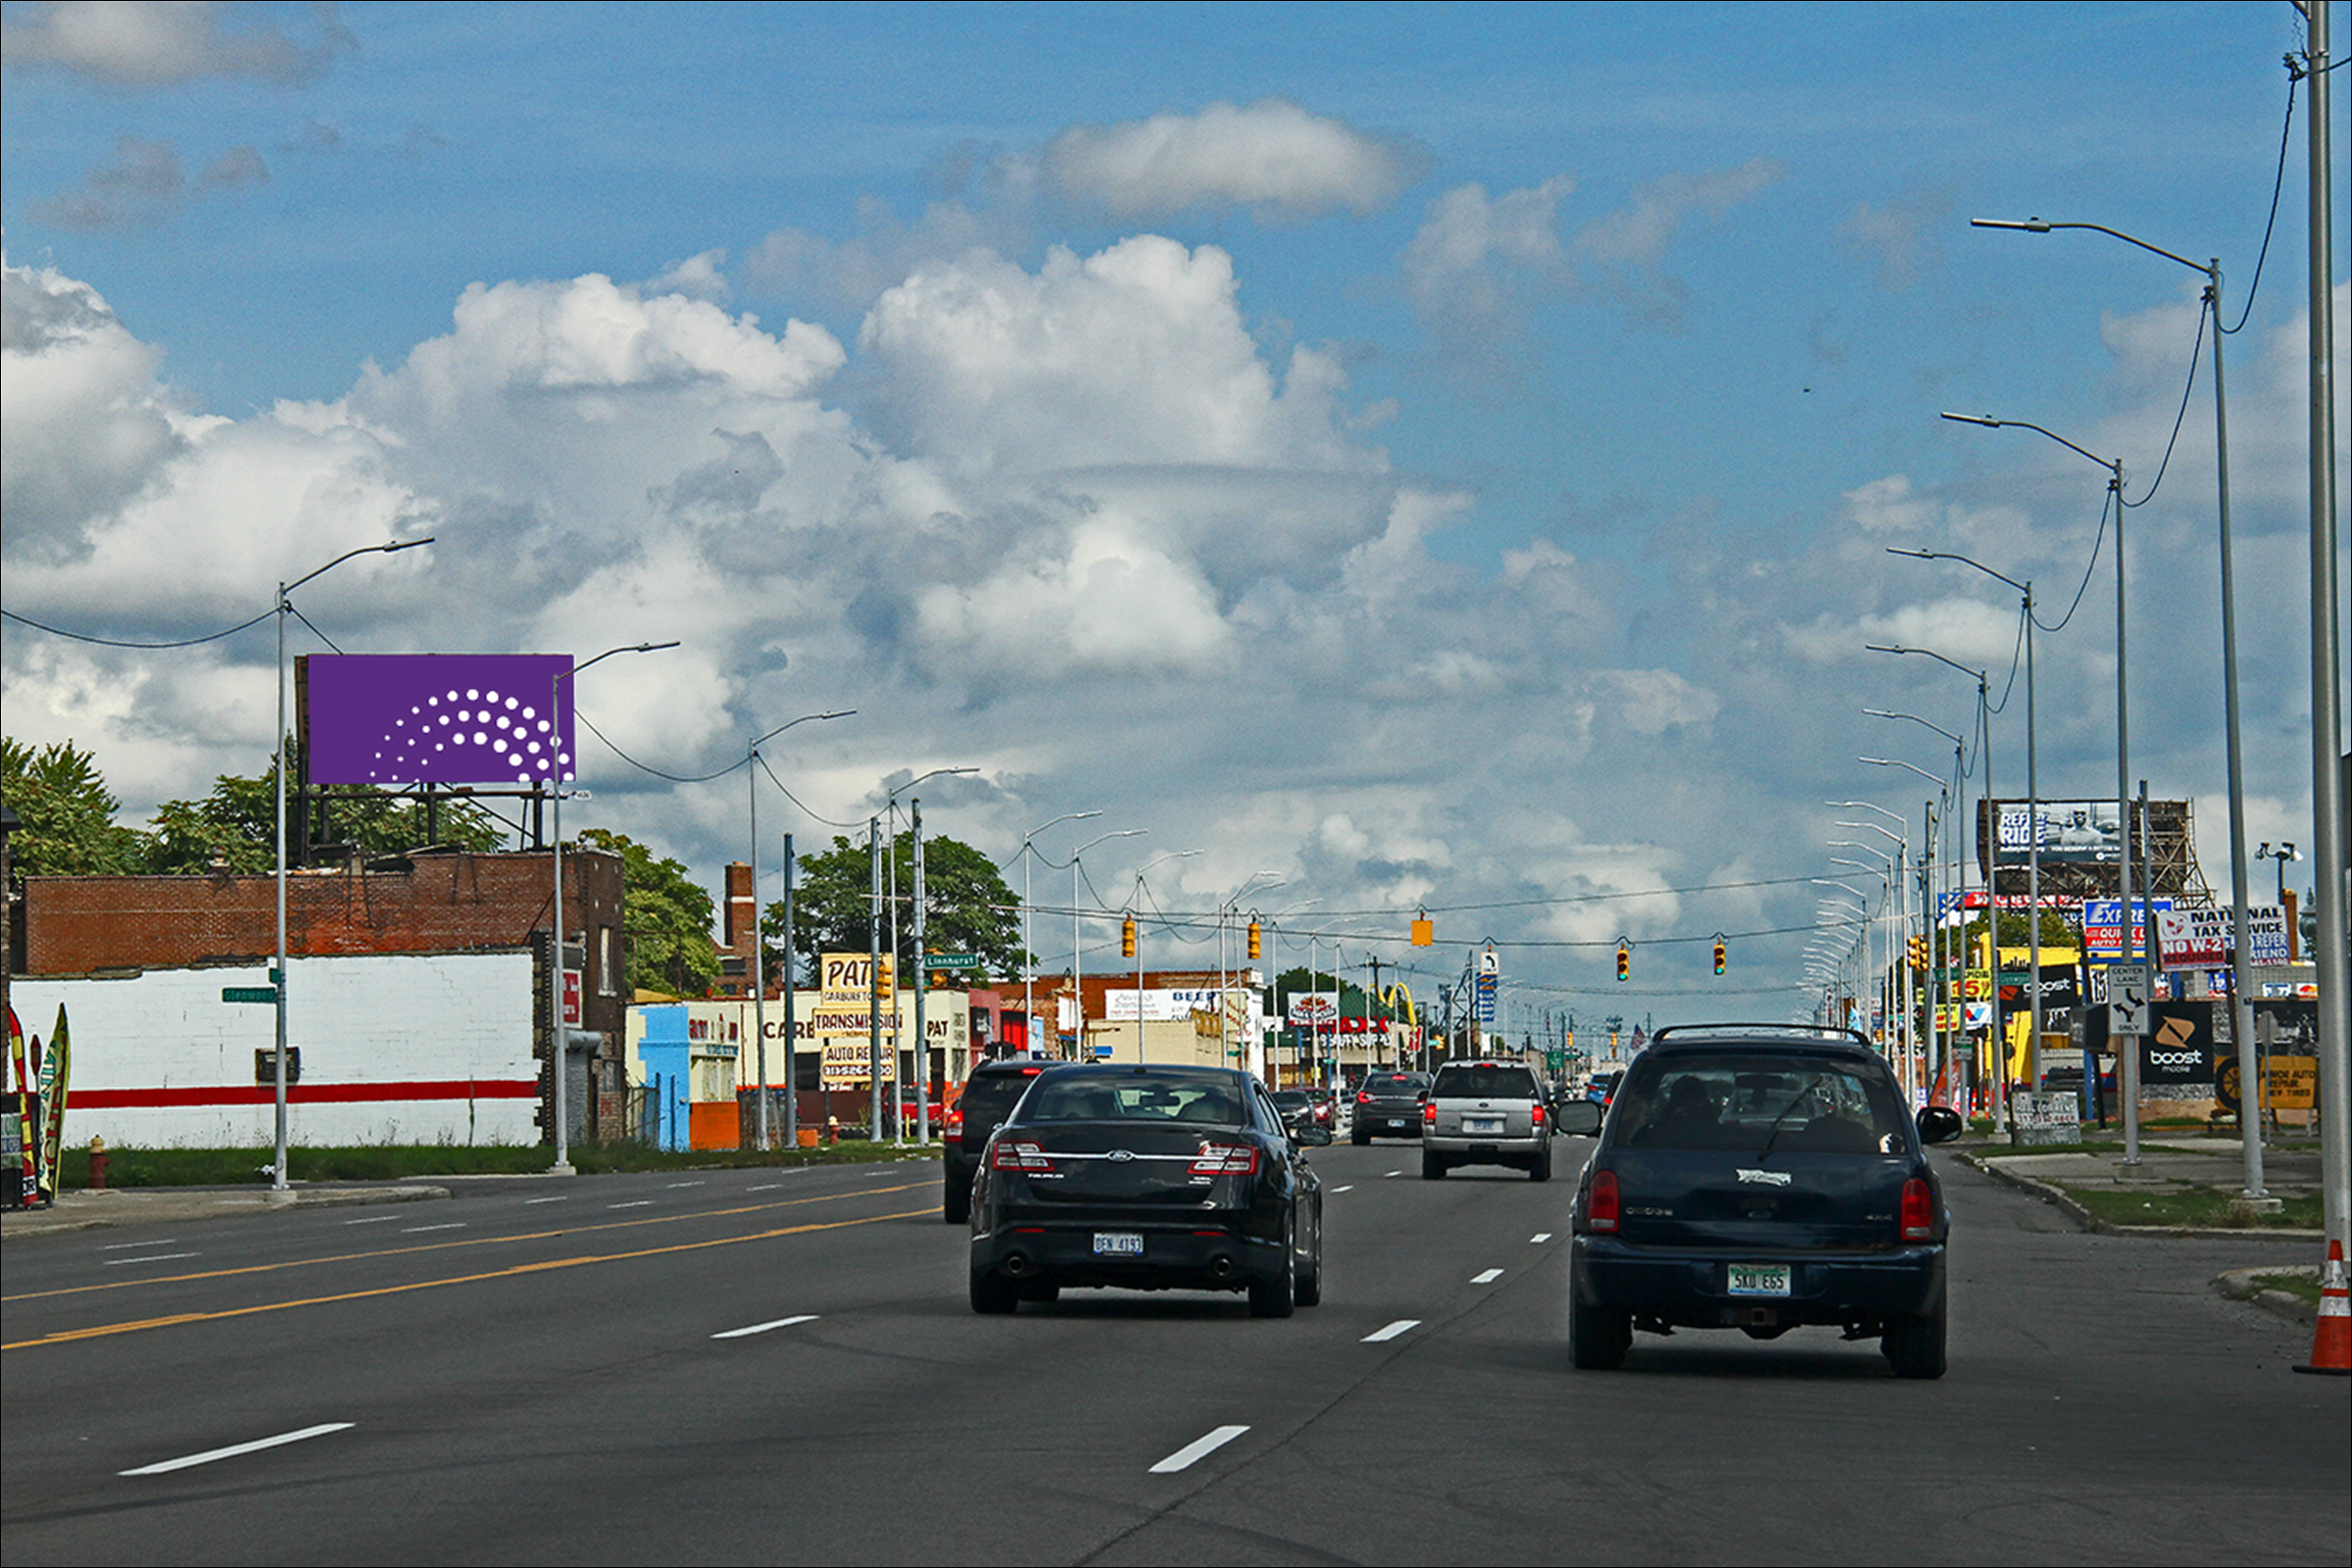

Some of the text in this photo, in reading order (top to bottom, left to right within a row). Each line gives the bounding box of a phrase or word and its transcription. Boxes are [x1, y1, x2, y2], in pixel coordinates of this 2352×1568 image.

[2088, 904, 2168, 923] EXPRE
[2190, 907, 2281, 923] NATINAL
[2100, 928, 2135, 938] QUIK
[2192, 922, 2283, 937] TAX SVICE
[2161, 941, 2187, 954] NO
[2190, 938, 2222, 953] W-2
[2249, 948, 2287, 959] RIEND
[2163, 951, 2224, 962] REQUIRED
[828, 959, 882, 987] PAT
[927, 1020, 948, 1037] PAT
[826, 1047, 894, 1060] AUTO REIR
[2150, 1050, 2202, 1064] boost
